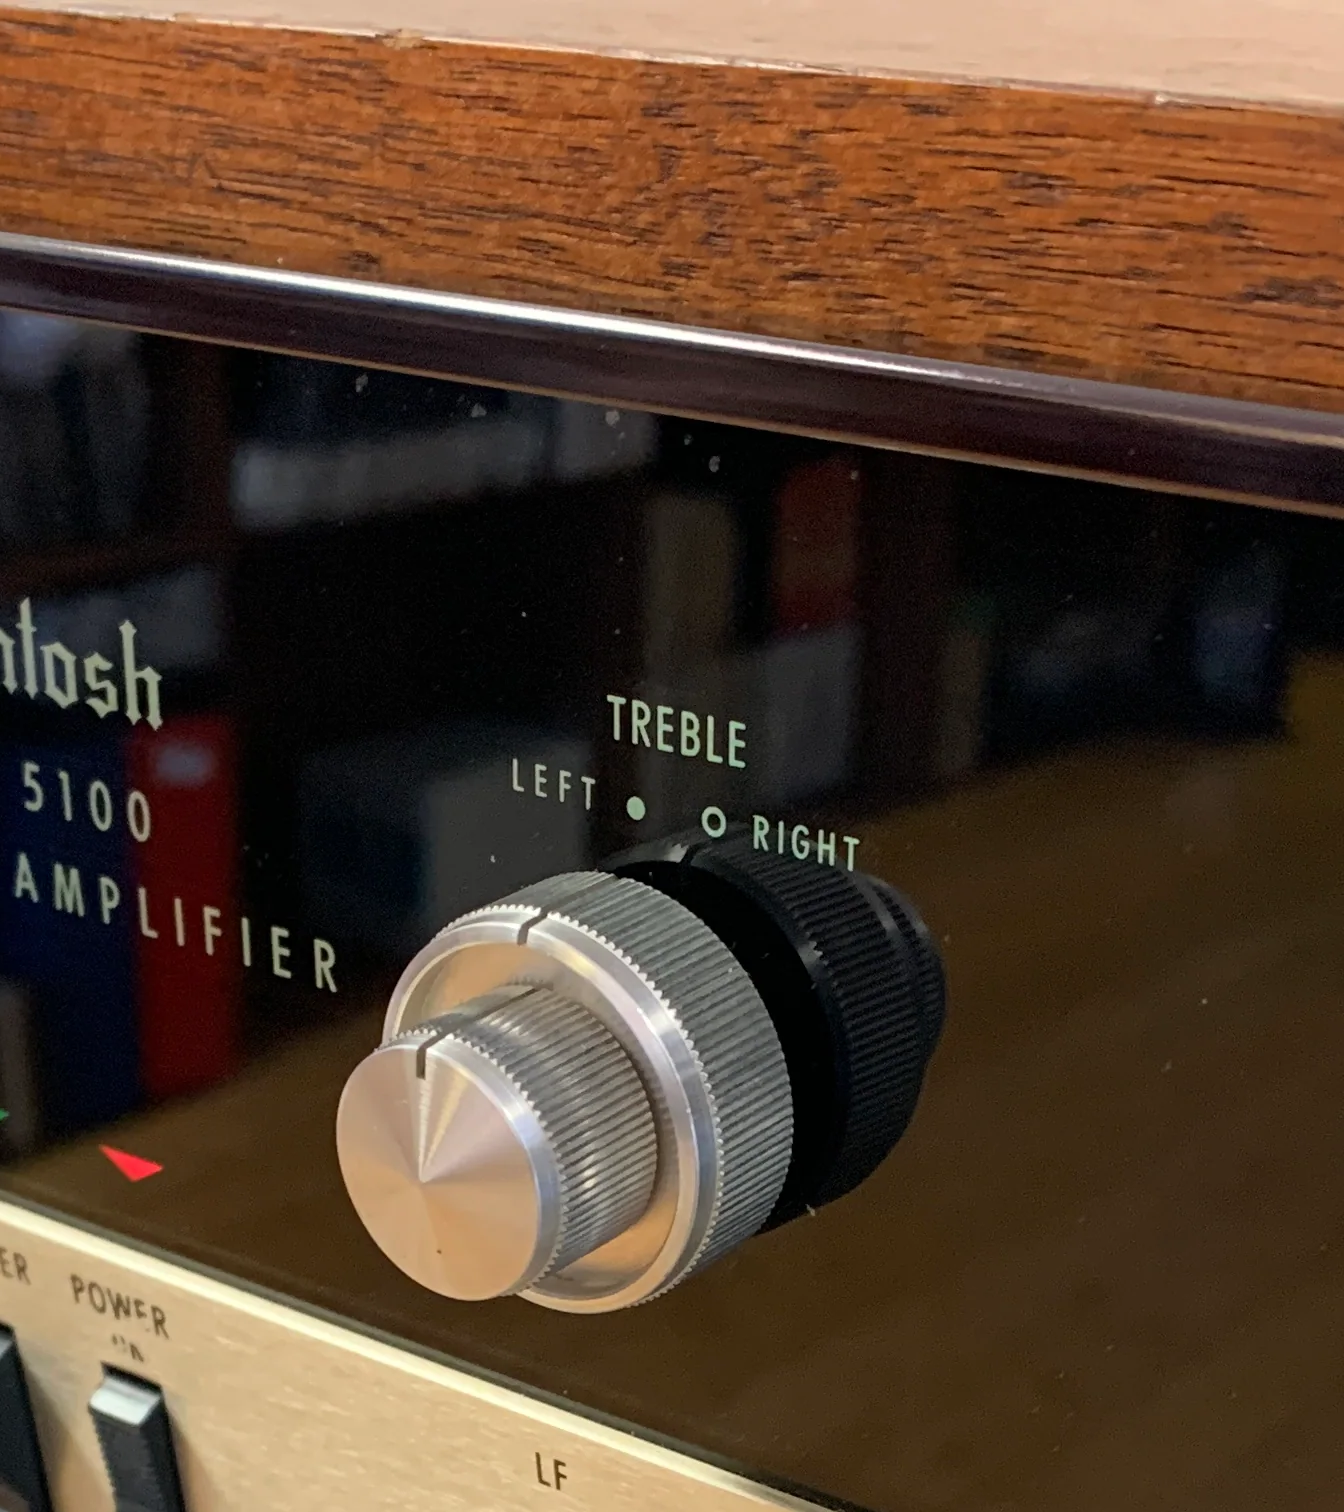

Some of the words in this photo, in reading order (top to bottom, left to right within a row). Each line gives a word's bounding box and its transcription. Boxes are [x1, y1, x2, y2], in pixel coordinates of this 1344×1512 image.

[606, 693, 747, 769] TREBLE
[22, 760, 152, 843] 5100
[511, 757, 596, 811] LEFT
[752, 814, 860, 872] RIGHT
[69, 1273, 171, 1340] POWER
[534, 1451, 568, 1491] LF
